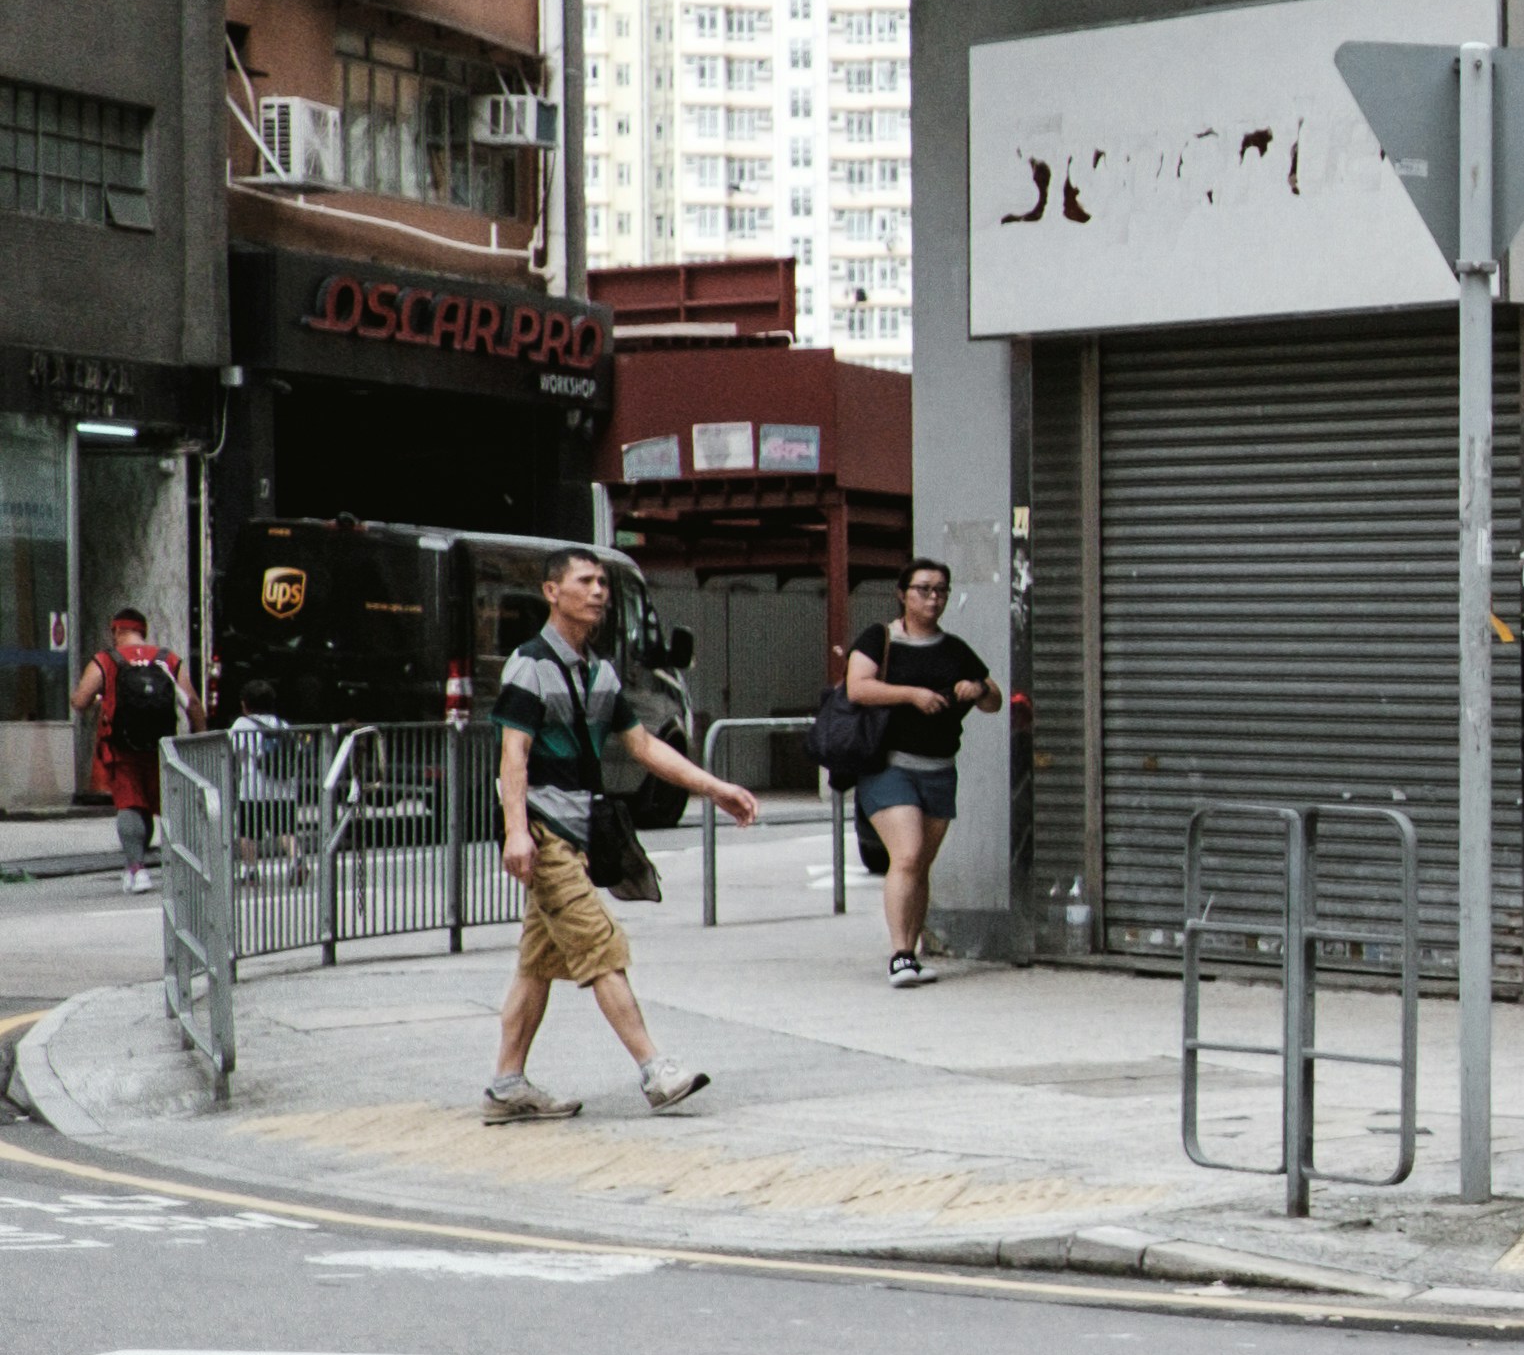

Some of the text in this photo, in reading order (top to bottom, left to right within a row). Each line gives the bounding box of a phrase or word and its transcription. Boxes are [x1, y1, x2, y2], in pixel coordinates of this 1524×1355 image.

[309, 275, 603, 370] OSCAR PRO
[539, 373, 597, 399] WORKSHOP
[265, 581, 302, 611] ups
